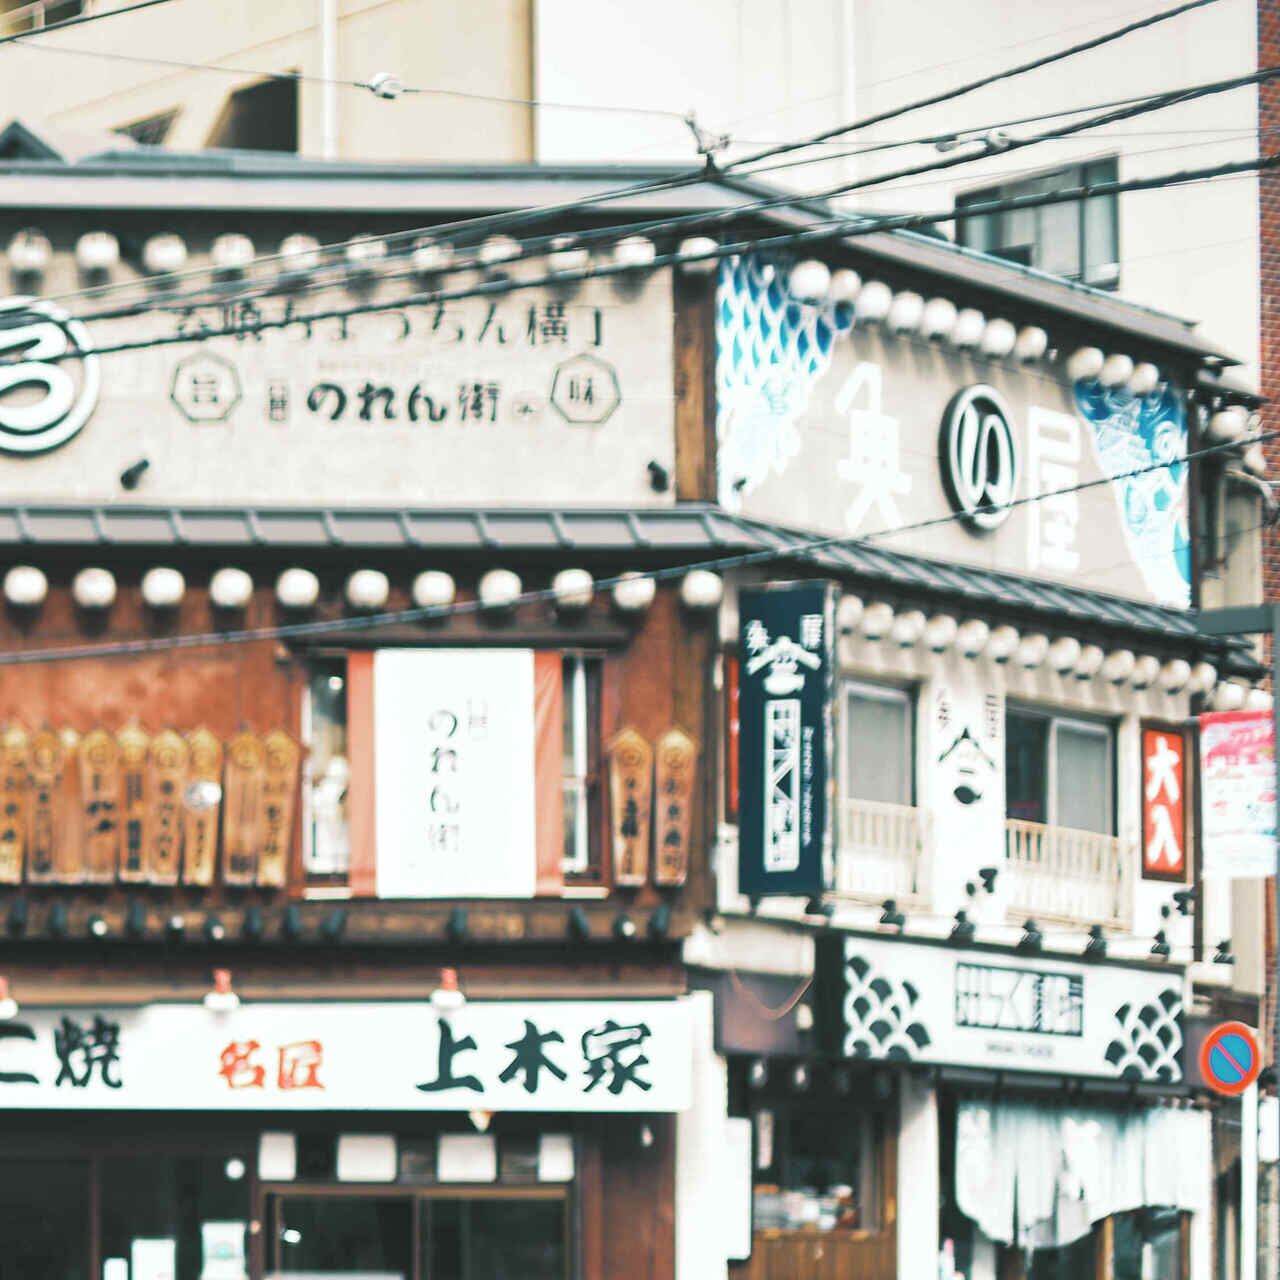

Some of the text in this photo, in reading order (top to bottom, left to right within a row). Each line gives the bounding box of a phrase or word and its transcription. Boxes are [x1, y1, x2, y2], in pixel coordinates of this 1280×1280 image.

[306, 382, 501, 423] のれん街
[218, 1039, 325, 1091] 名匠
[415, 1018, 653, 1095] 上木家
